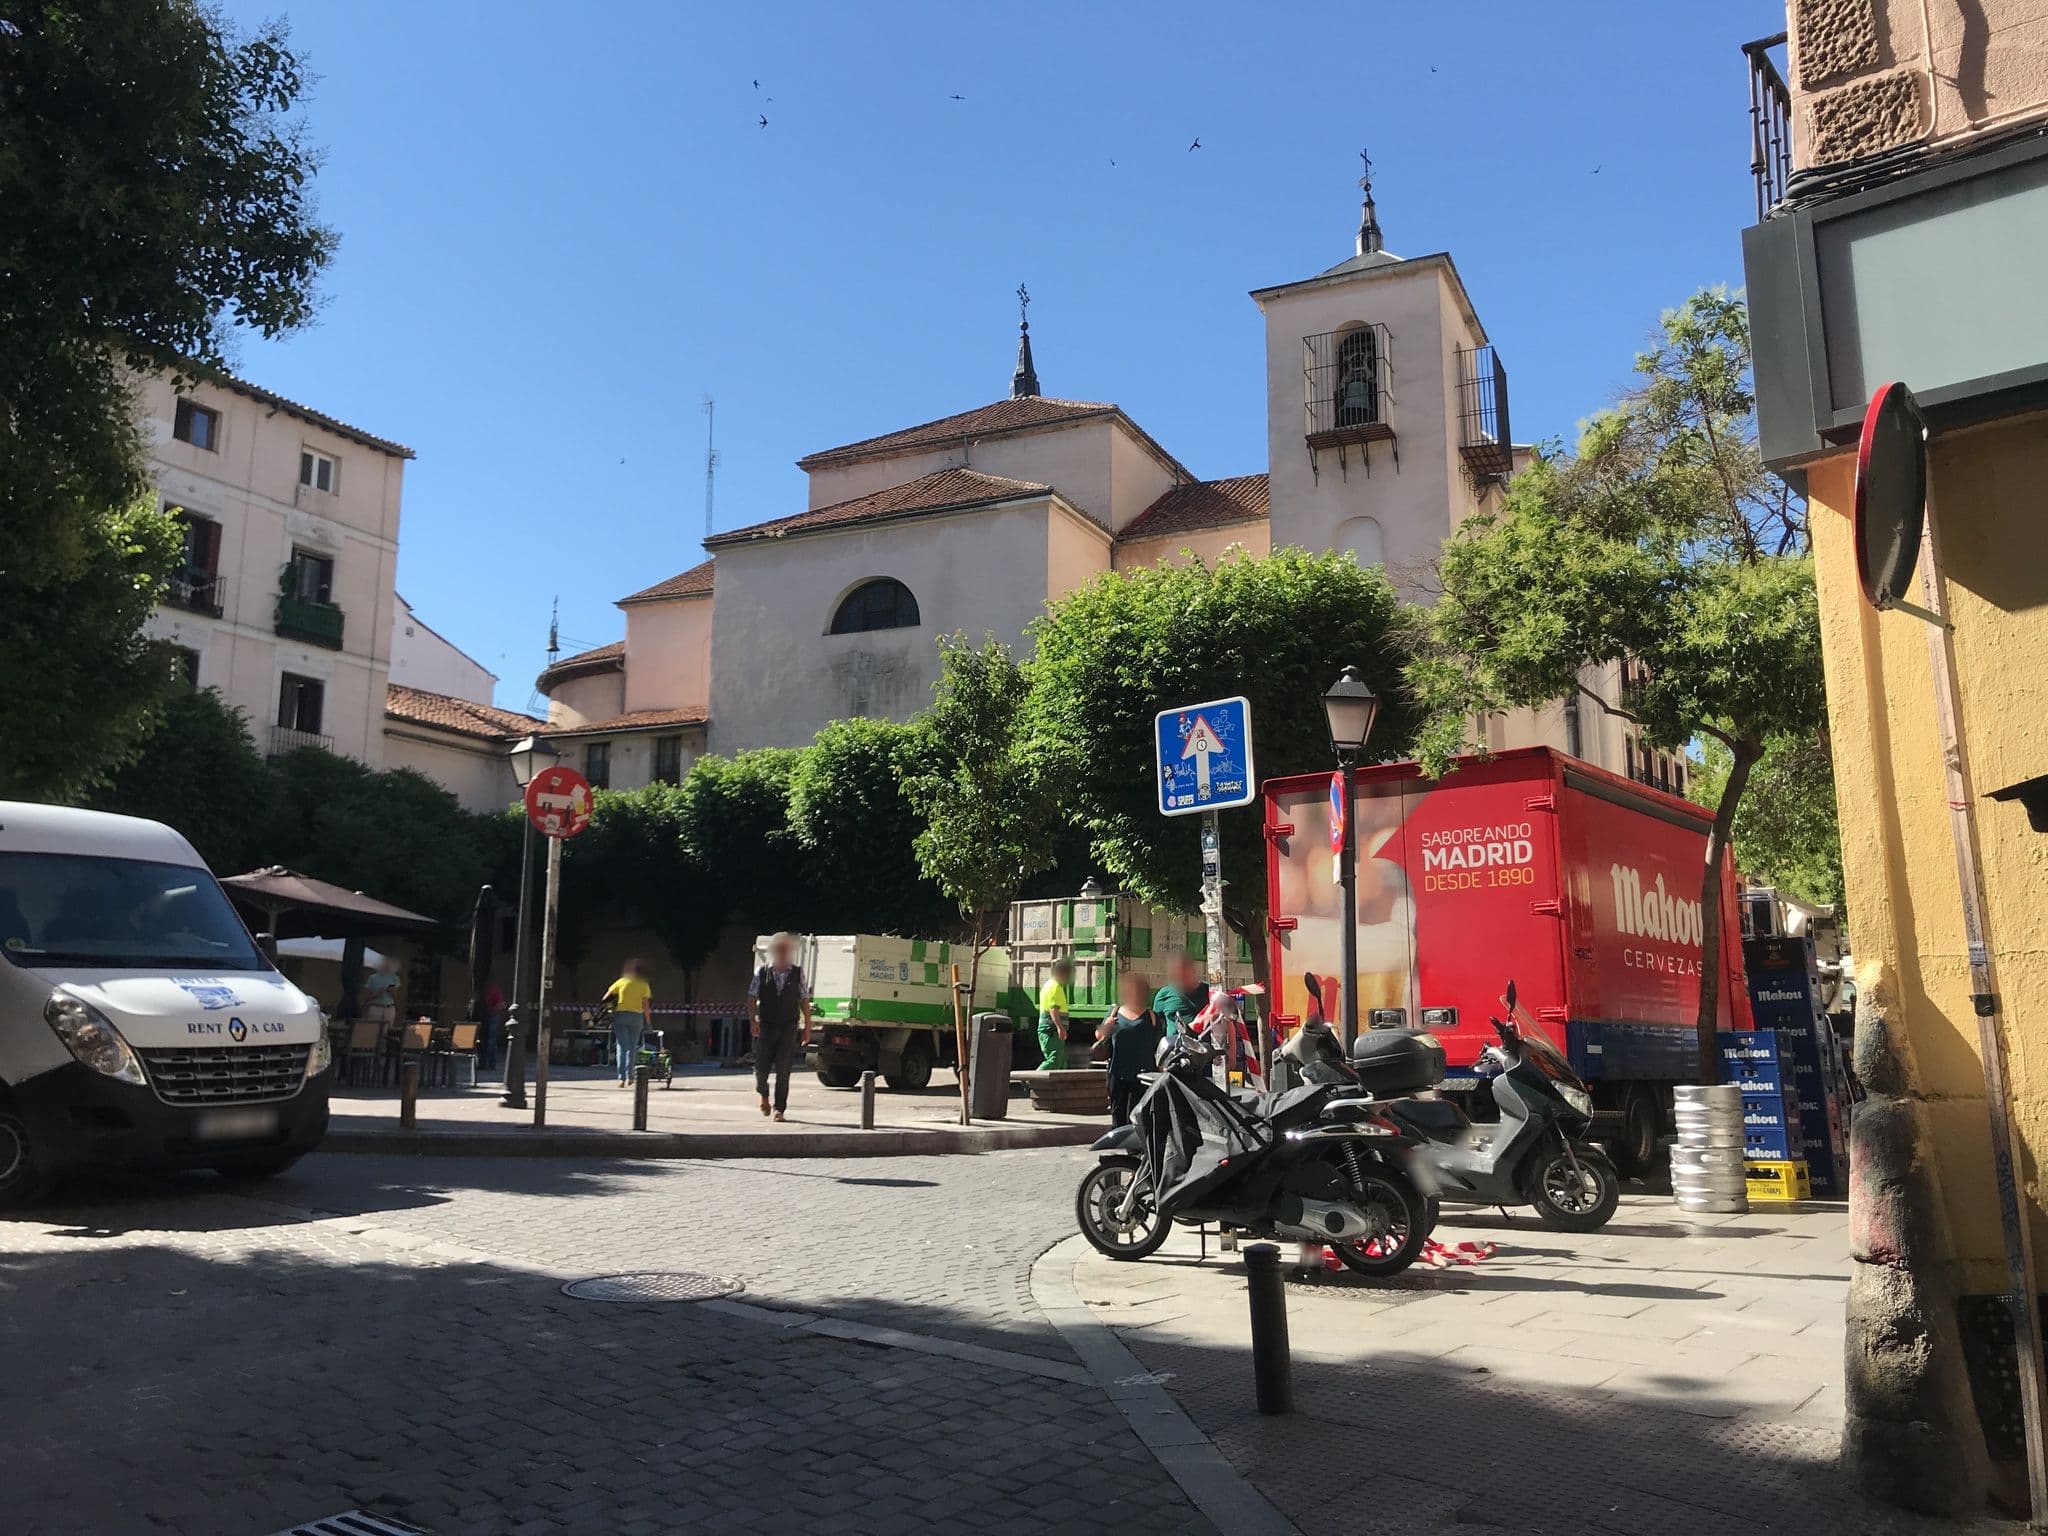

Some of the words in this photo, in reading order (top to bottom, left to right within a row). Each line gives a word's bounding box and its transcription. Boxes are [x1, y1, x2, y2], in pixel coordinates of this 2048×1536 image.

[1421, 823, 1531, 847] SABOREANDO
[1422, 840, 1533, 871] MADRID
[1425, 871, 1482, 891] DESDE
[1487, 867, 1534, 887] 1890
[1757, 989, 1803, 1002] Mahou
[187, 1023, 222, 1034] RENT
[251, 1024, 259, 1033] A
[263, 1023, 285, 1033] CAR
[1723, 1047, 1770, 1059] Mahou
